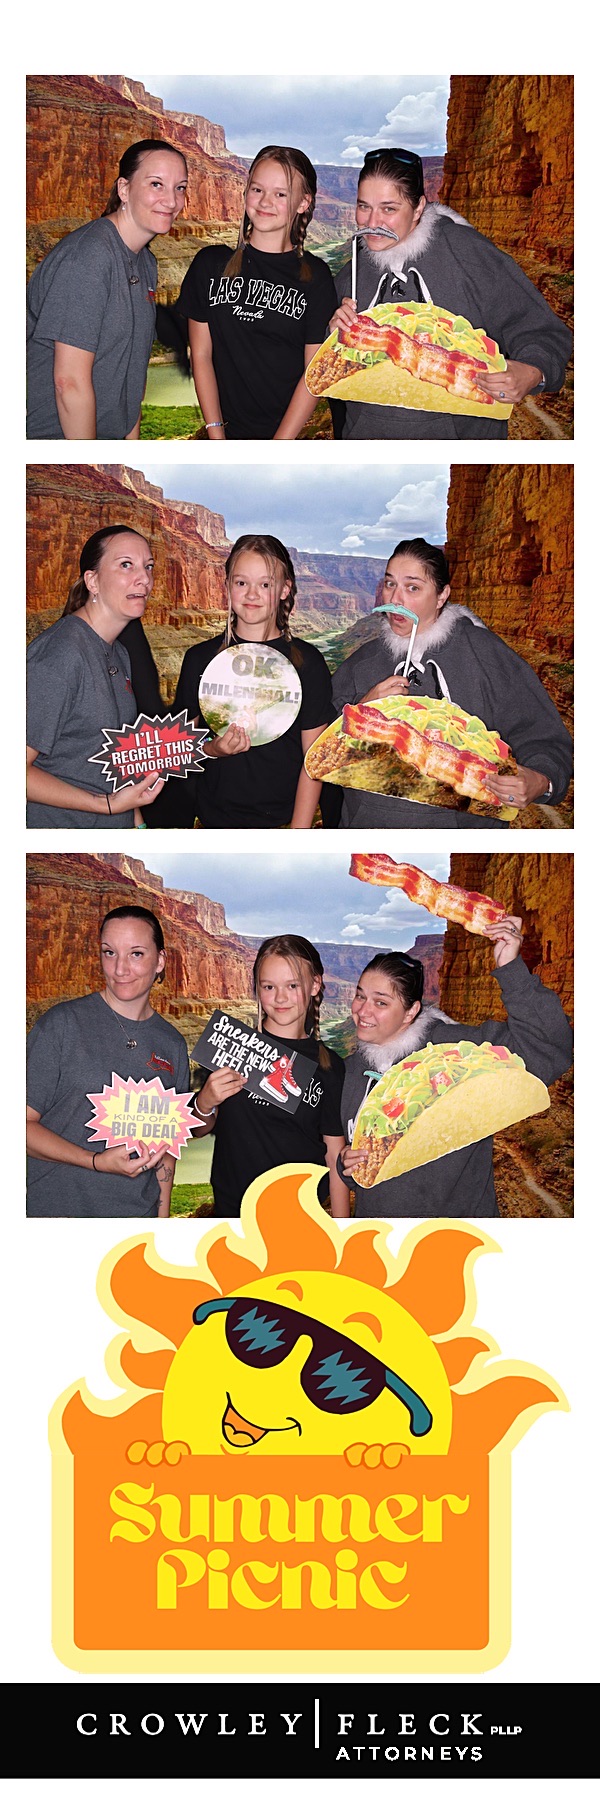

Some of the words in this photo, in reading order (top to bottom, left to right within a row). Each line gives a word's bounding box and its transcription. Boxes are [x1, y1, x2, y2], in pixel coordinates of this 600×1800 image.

[208, 276, 244, 307] LAS
[245, 279, 308, 320] VEGAS
[231, 654, 278, 680] OK
[134, 729, 163, 747] I'LL
[111, 744, 161, 766] REGRET
[165, 739, 194, 756] THIS
[119, 753, 192, 777] TOMORROW
[213, 1015, 280, 1062] Sneakers
[207, 1031, 230, 1051] ARE
[229, 1041, 249, 1060] THE
[246, 1051, 272, 1073] NEW
[124, 1093, 131, 1113] I
[137, 1094, 170, 1115] AM
[111, 1121, 137, 1137] BIG
[142, 1123, 179, 1139] DEAL
[113, 1113, 145, 1122] KIND
[149, 1115, 168, 1123] OF
[169, 1116, 178, 1124] A
